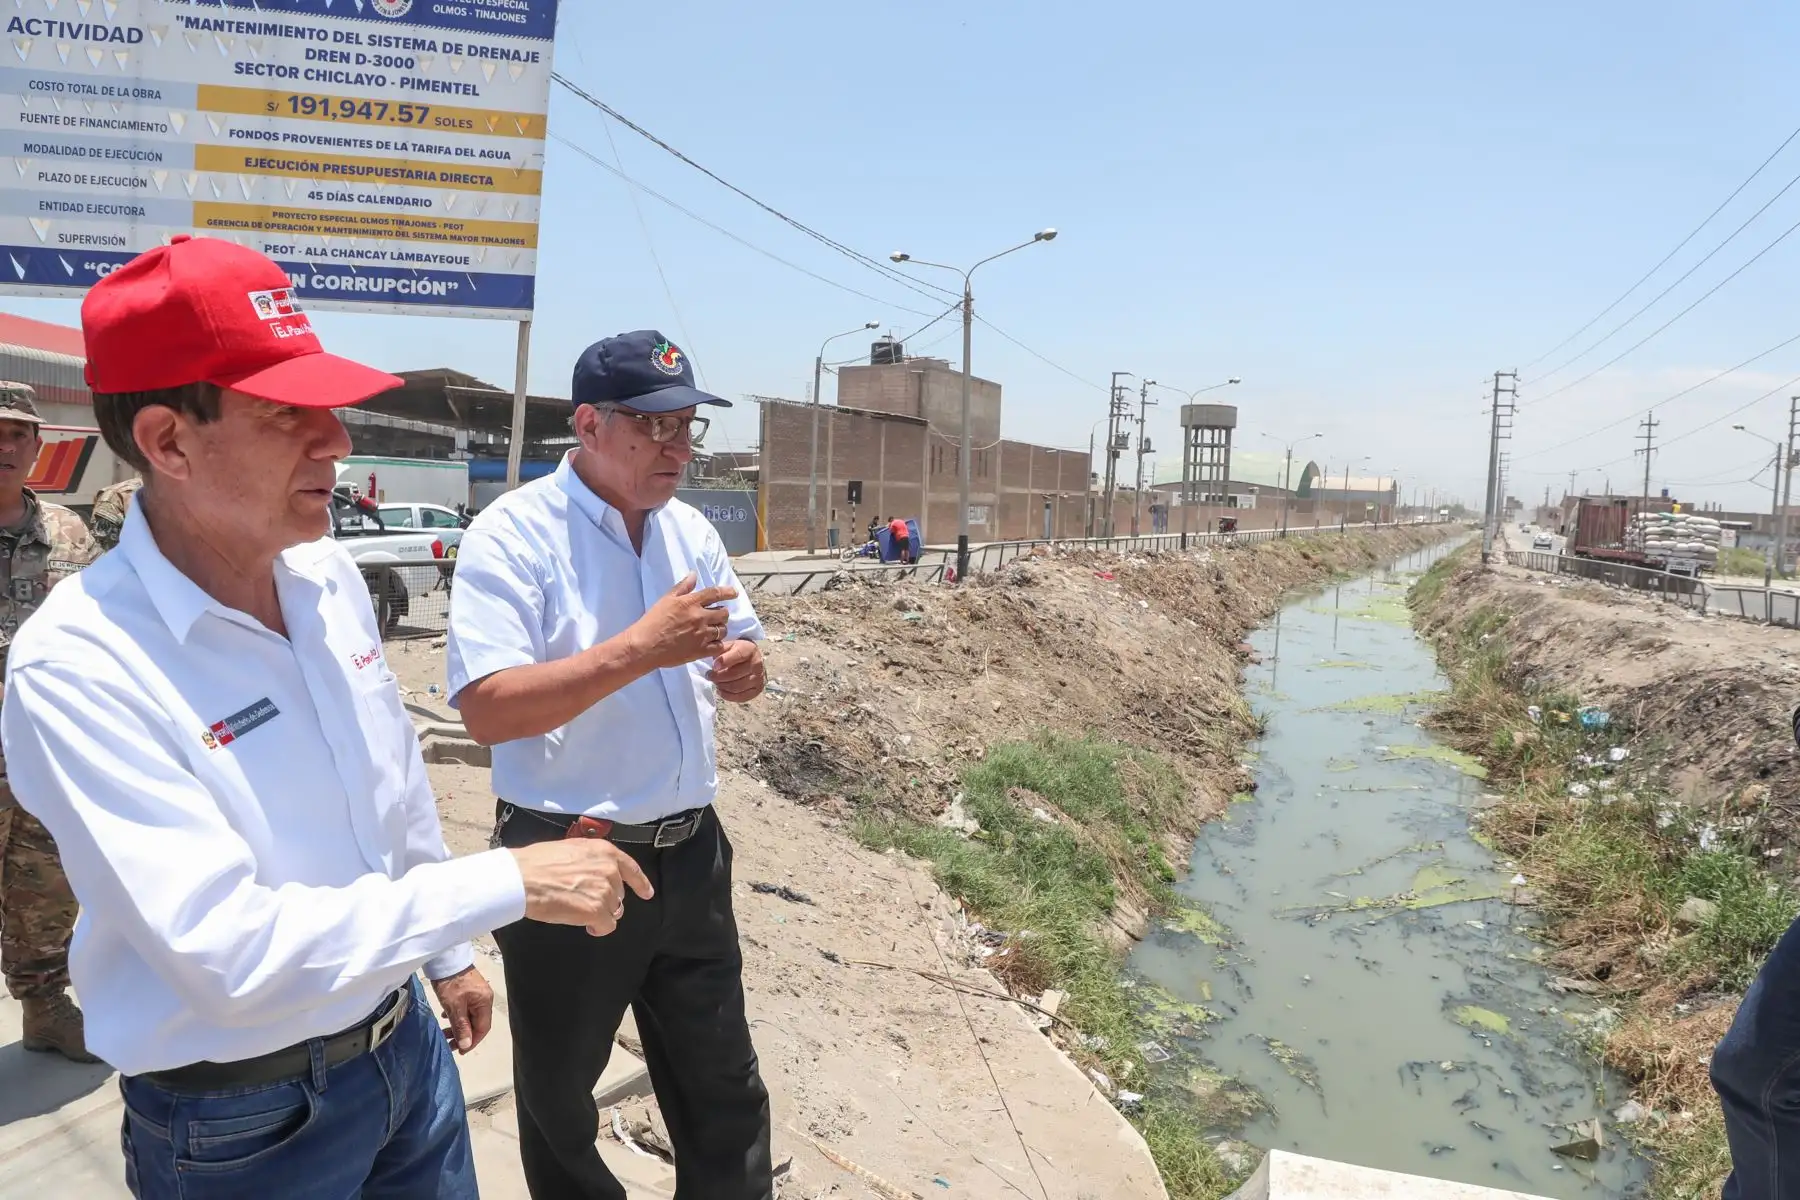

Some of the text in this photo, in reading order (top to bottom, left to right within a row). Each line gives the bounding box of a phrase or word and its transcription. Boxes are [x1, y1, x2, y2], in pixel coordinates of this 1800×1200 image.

[433, 4, 467, 17] OLMOS
[475, 9, 527, 24] TINAJONES
[486, 0, 530, 11] ESPECIAL
[7, 16, 144, 45] ACTIVIDAD
[175, 14, 540, 64] "MANTENIMIENTO DEL SISTEMA DE DRENAJE
[305, 48, 415, 70] DREN D-3000
[234, 61, 299, 80] SECTOR
[304, 67, 387, 88] CHICLAYO
[400, 77, 480, 97] PIMENTEL
[29, 80, 162, 100] COSTO TOTAL DE LA OBRA
[267, 95, 473, 129] S/ 191,947.57 SOLES
[20, 113, 168, 134] FUENTE DE FINANCIAMIENTO
[23, 143, 163, 162] MODALIDAD DE EJECUCIÓN
[229, 129, 511, 160] FONDOS PROVENIENTES DE LA TARIFA DEL AGUA
[38, 171, 147, 188] PLAZO DE EJECUCIÓN
[244, 157, 494, 186] EJECUCIÓN PRESUPUESTARIA DIRECTA
[39, 201, 146, 217] ENTIDAD EJECUTORA
[308, 190, 433, 208] 45 DÍAS CALENDARIO
[272, 211, 318, 221] PROYECTO
[319, 215, 358, 224] ESPECIAL
[360, 217, 389, 226] OLMOS
[390, 218, 437, 229] TINAJONES
[443, 222, 464, 231] PEOT
[58, 233, 126, 246] SUPERVISIÓN
[206, 218, 249, 228] GERENCIA
[251, 221, 263, 229] DE
[316, 225, 322, 233] Y
[323, 226, 393, 238] MANTENIMIENTO
[395, 230, 411, 239] DEL
[412, 232, 448, 241] SISTEMA
[450, 234, 479, 243] MAYOR
[481, 236, 526, 246] TINAJONES
[264, 244, 296, 255] PEOT
[305, 247, 329, 257] ALA
[331, 248, 387, 260] CHANCAY
[390, 251, 470, 266] LAMBAYEQUE
[289, 273, 306, 289] IN
[703, 504, 747, 522] hielo
